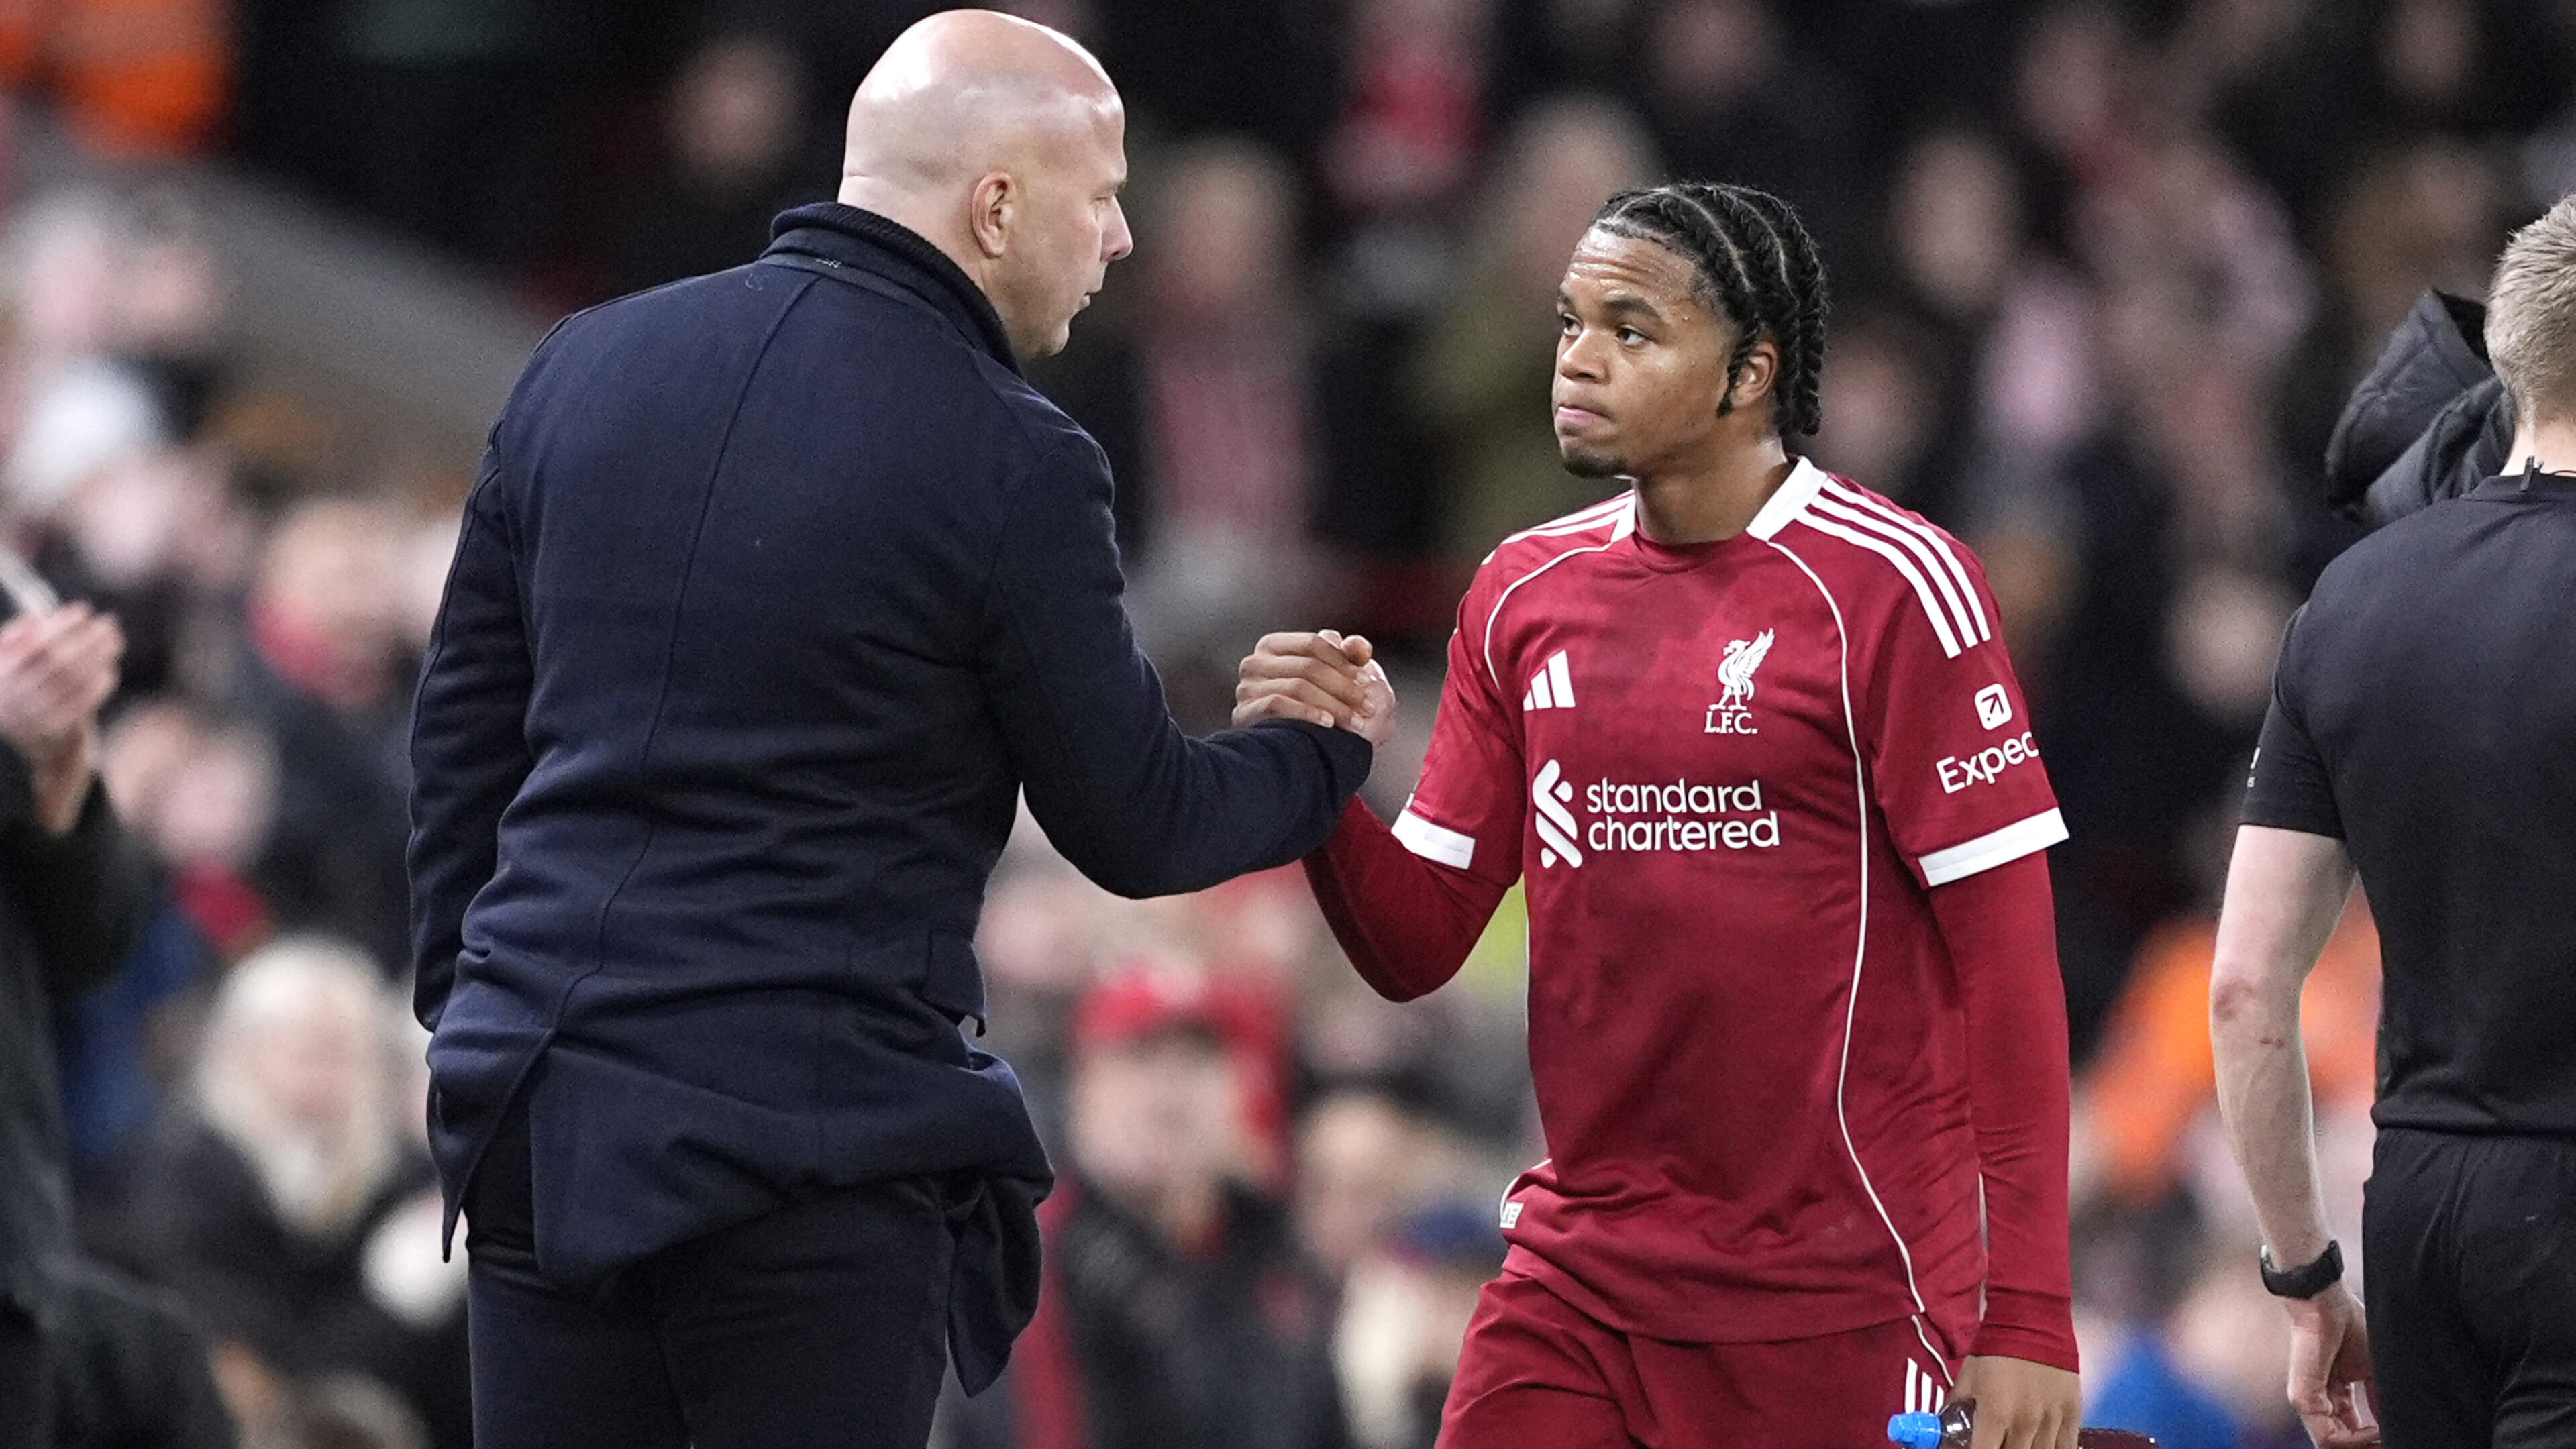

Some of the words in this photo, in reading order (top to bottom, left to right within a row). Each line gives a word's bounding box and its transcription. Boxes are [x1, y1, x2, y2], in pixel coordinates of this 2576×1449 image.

[1704, 711, 1758, 735] L.F.C.
[1586, 777, 1762, 814] standard
[1588, 811, 1780, 851] chartered
